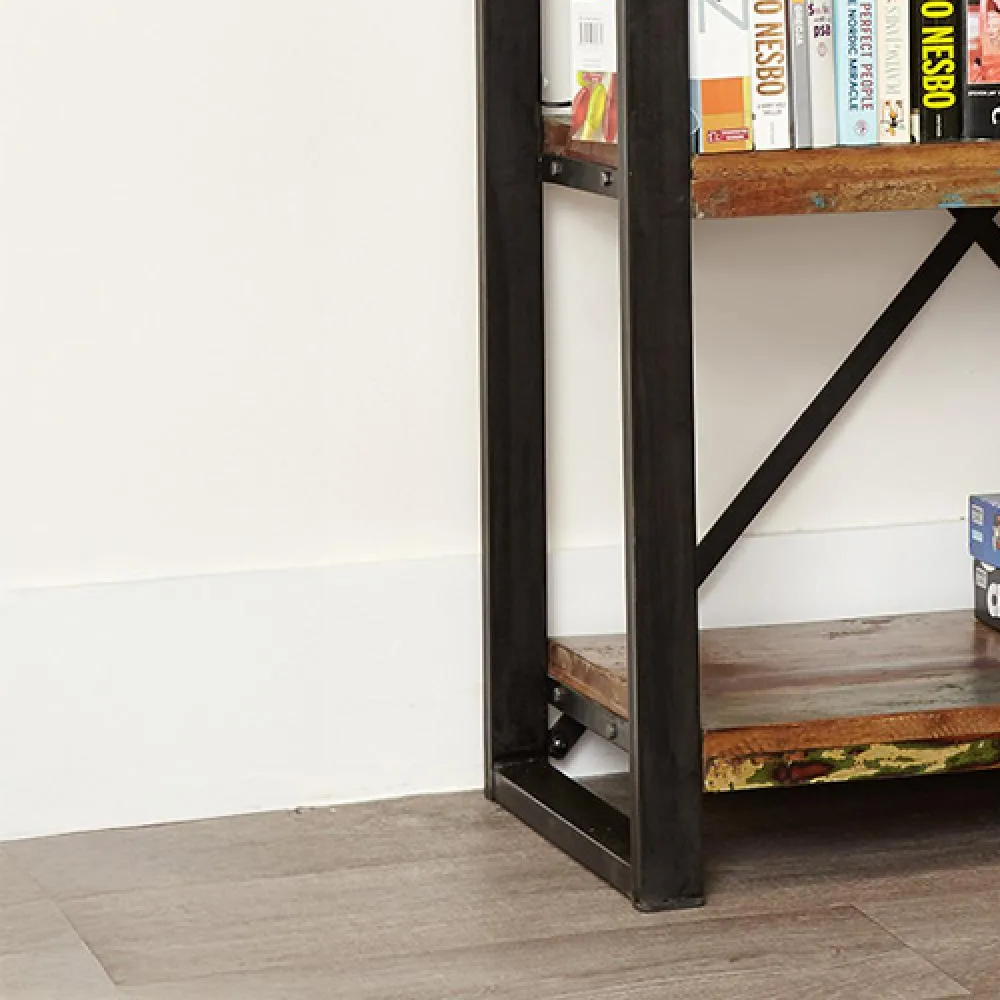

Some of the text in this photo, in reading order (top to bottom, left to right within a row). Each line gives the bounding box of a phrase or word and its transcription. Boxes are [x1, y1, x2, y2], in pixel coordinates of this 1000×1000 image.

[847, 9, 858, 56] NORDIC
[859, 3, 873, 57] PERFECT
[848, 58, 859, 111] MIRACLE
[860, 63, 875, 111] PEOPLE
